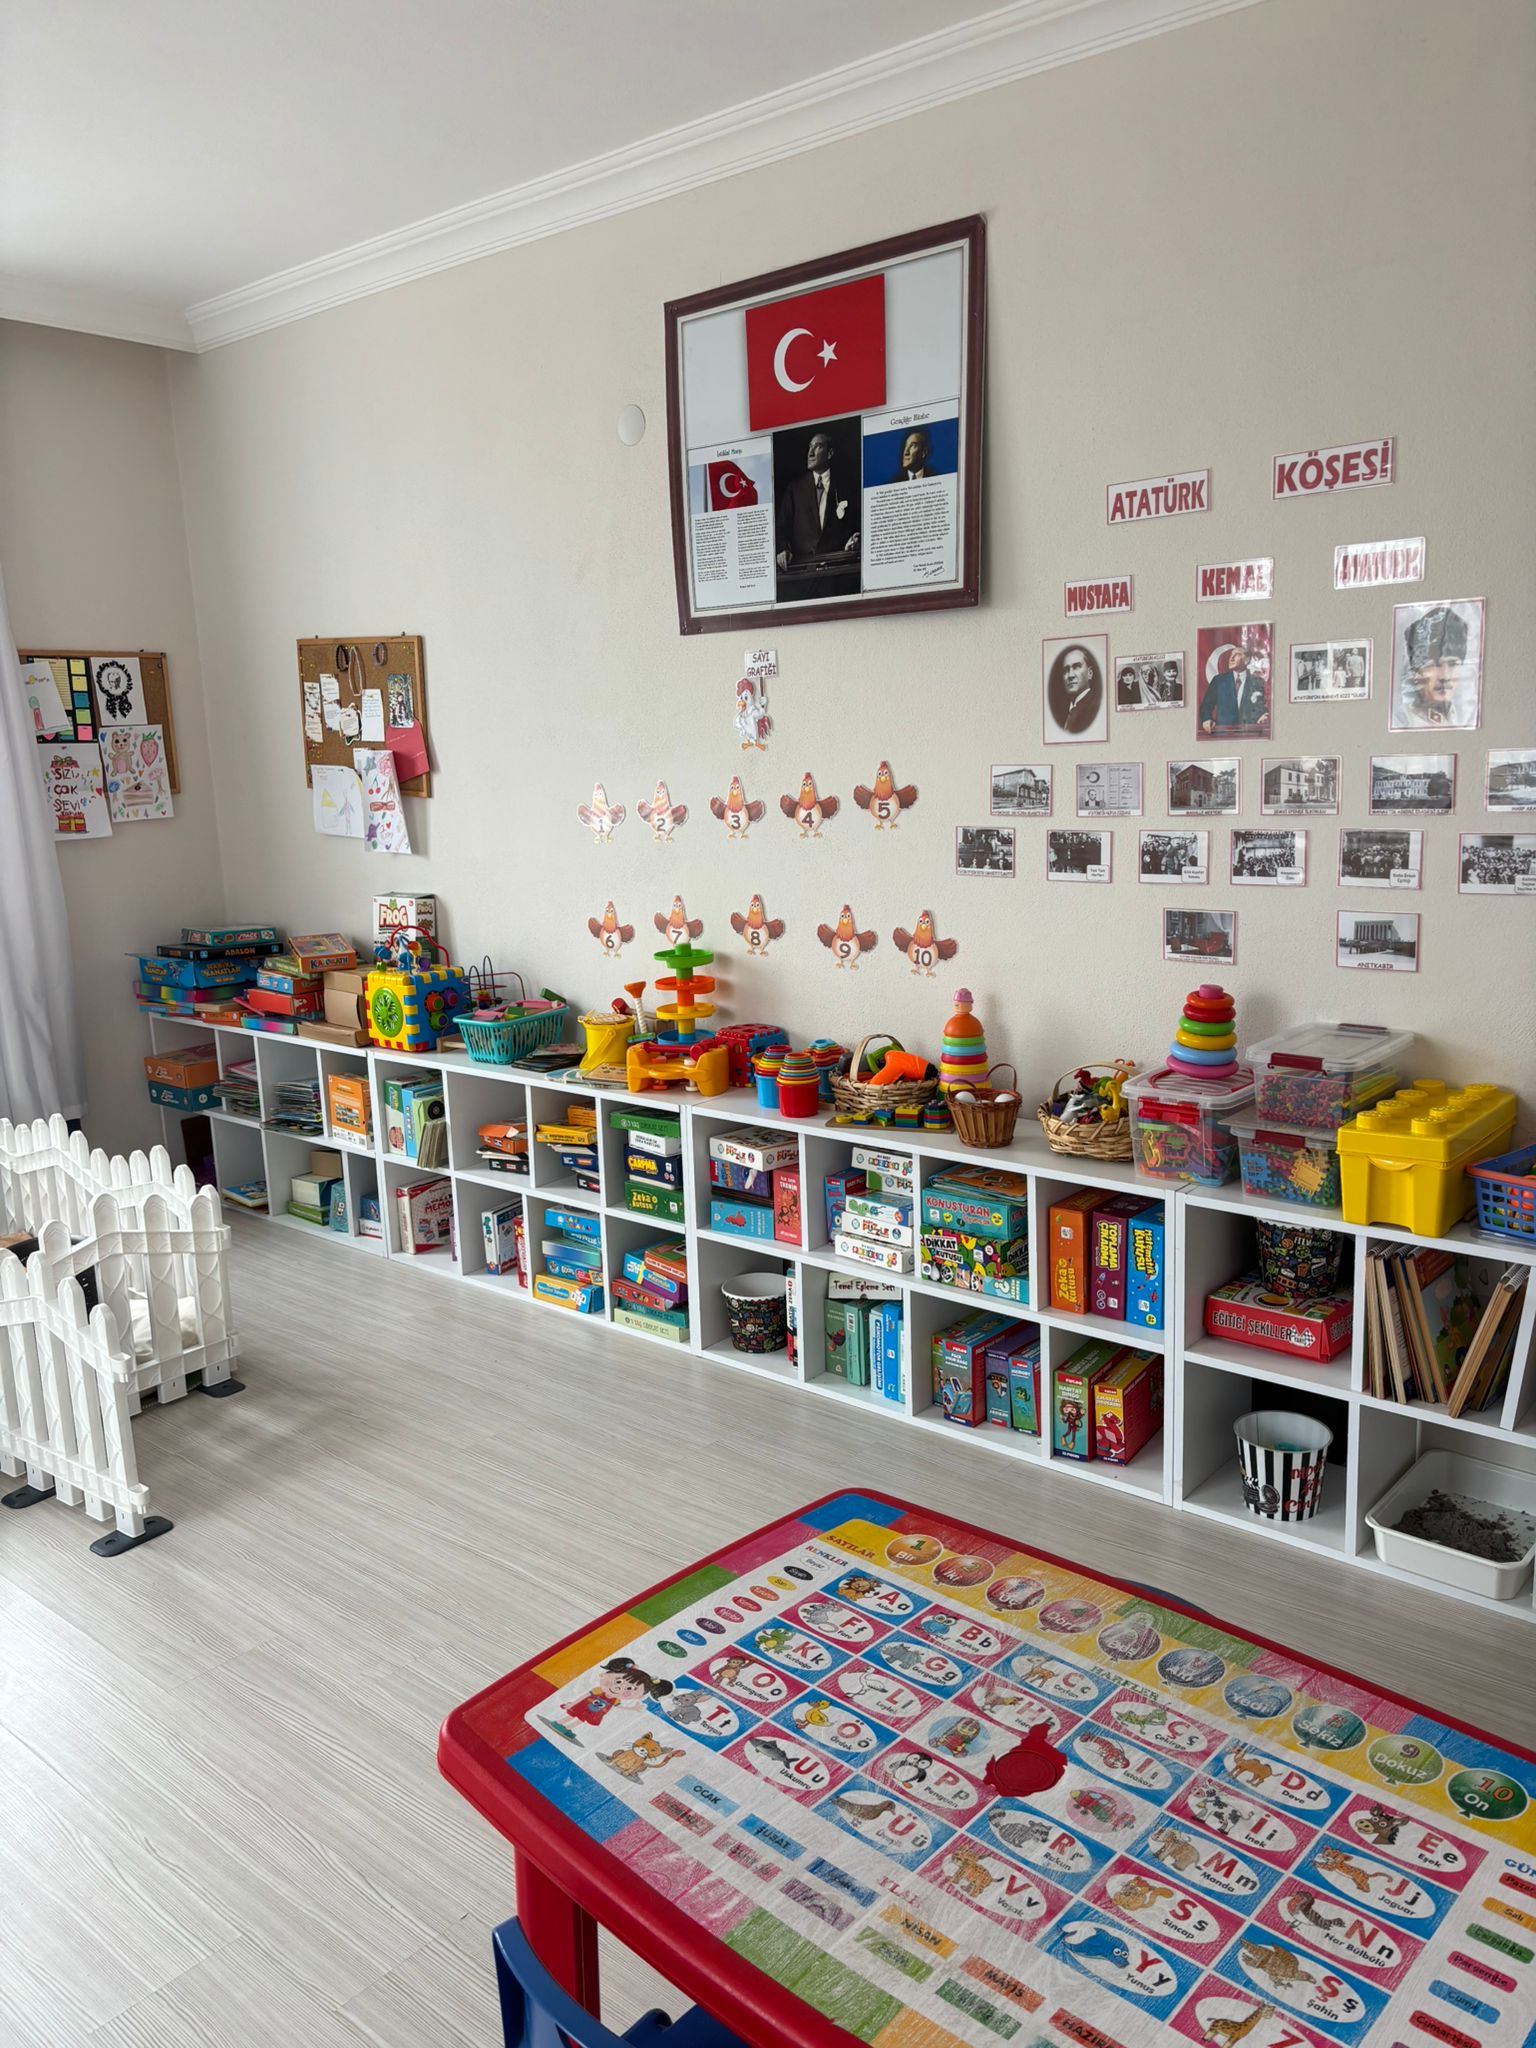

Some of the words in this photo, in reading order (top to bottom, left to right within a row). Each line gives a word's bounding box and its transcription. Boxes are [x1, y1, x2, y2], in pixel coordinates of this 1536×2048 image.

[1276, 440, 1390, 494] KÖŞESİ
[1110, 477, 1206, 521] ATATÜRK
[1201, 564, 1267, 597] KEMAL
[1067, 581, 1130, 612] MUSTAFA
[752, 652, 770, 663] SAYI
[746, 662, 777, 677] GRAFİĞİ
[730, 814, 741, 829] 3
[801, 811, 814, 828] 4
[878, 801, 890, 820] 5
[597, 818, 604, 833] 1
[656, 817, 666, 832] 2
[379, 904, 408, 927] FROG
[416, 903, 433, 915] FROG
[605, 934, 615, 948] 6
[671, 929, 683, 944] 7
[750, 931, 761, 946] 8
[225, 947, 256, 956] ABALON
[839, 943, 851, 959] 9
[914, 949, 932, 967] 10
[632, 1191, 652, 1203] Zeka
[862, 1222, 890, 1237] PUZZLE
[925, 1238, 957, 1250] DİKKAT
[1099, 1221, 1109, 1267] ÇIKARMA
[1108, 1223, 1118, 1269] TOPLAMA
[935, 1250, 963, 1263] KUTUSU
[833, 1280, 854, 1290] Temel
[1058, 1267, 1069, 1300] Zeka
[1213, 1310, 1245, 1330] EĞİTİCİ
[1248, 1319, 1292, 1342] ŞEKİLLER
[805, 1545, 849, 1568] RENKLER
[826, 1534, 875, 1560] SAYILAR
[895, 1550, 917, 1563] Bir
[910, 1539, 927, 1551] 1
[878, 1590, 902, 1606] A
[897, 1602, 911, 1612] a
[838, 1616, 863, 1630] F
[853, 1626, 869, 1636] f
[960, 1625, 984, 1641] B
[978, 1634, 992, 1648] b
[792, 1640, 819, 1659] K
[811, 1653, 826, 1666] k
[925, 1656, 950, 1671] G
[942, 1671, 957, 1682] g
[752, 1672, 777, 1688] O
[770, 1688, 783, 1697] o
[1061, 1671, 1084, 1688] C
[1079, 1685, 1092, 1695] c
[1090, 1665, 1160, 1701] HARFLER
[885, 1688, 905, 1705] L
[706, 1704, 730, 1722] T
[719, 1719, 731, 1729] t
[836, 1719, 865, 1739] Ö
[857, 1736, 873, 1749] ö
[1166, 1720, 1191, 1740] Ç
[1298, 1718, 1345, 1749] Sekiz
[1154, 1733, 1187, 1751] Çekirge
[1399, 1743, 1420, 1760] 9
[793, 1756, 820, 1776] U
[812, 1773, 825, 1784] u
[1373, 1752, 1428, 1780] Dokuz
[693, 1784, 722, 1805] OCAK
[934, 1770, 961, 1787] P
[951, 1789, 970, 1802] p
[1280, 1771, 1306, 1791] D
[1306, 1789, 1323, 1802] d
[1281, 1789, 1305, 1804] Deve
[1472, 1776, 1514, 1802] 10
[1463, 1792, 1490, 1812] On
[887, 1812, 917, 1837] Ü
[911, 1834, 928, 1848] ü
[1250, 1813, 1271, 1834] İ
[1266, 1829, 1278, 1841] i
[1048, 1832, 1076, 1855] R
[1416, 1832, 1444, 1855] E
[1442, 1851, 1459, 1864] e
[1042, 1851, 1073, 1872] Rakun
[1202, 1851, 1239, 1879] M
[1235, 1873, 1258, 1892] m
[1417, 1853, 1442, 1869] Eşek
[1005, 1874, 1033, 1896] V
[1025, 1896, 1041, 1908] v
[1200, 1871, 1235, 1893] Manda
[1384, 1879, 1410, 1897] J
[1404, 1891, 1422, 1906] j
[1169, 1898, 1198, 1922] S
[1192, 1919, 1209, 1932] s
[1378, 1895, 1417, 1916] Jaguar
[1503, 1907, 1524, 1923] Salı
[1162, 1917, 1195, 1941] Sincap
[1344, 1919, 1380, 1948] N
[1379, 1943, 1395, 1959] n
[1324, 1932, 1340, 1946] Nar
[1345, 1942, 1386, 1968] Bülbülü
[1136, 1950, 1163, 1974] Y
[1151, 1972, 1172, 1988] y
[984, 1969, 1025, 1998] MAYIS
[1125, 1972, 1156, 1994] Yunus
[1314, 1974, 1344, 2005] Ş
[1343, 1998, 1359, 2014] ş
[1306, 1998, 1340, 2022] Şahin
